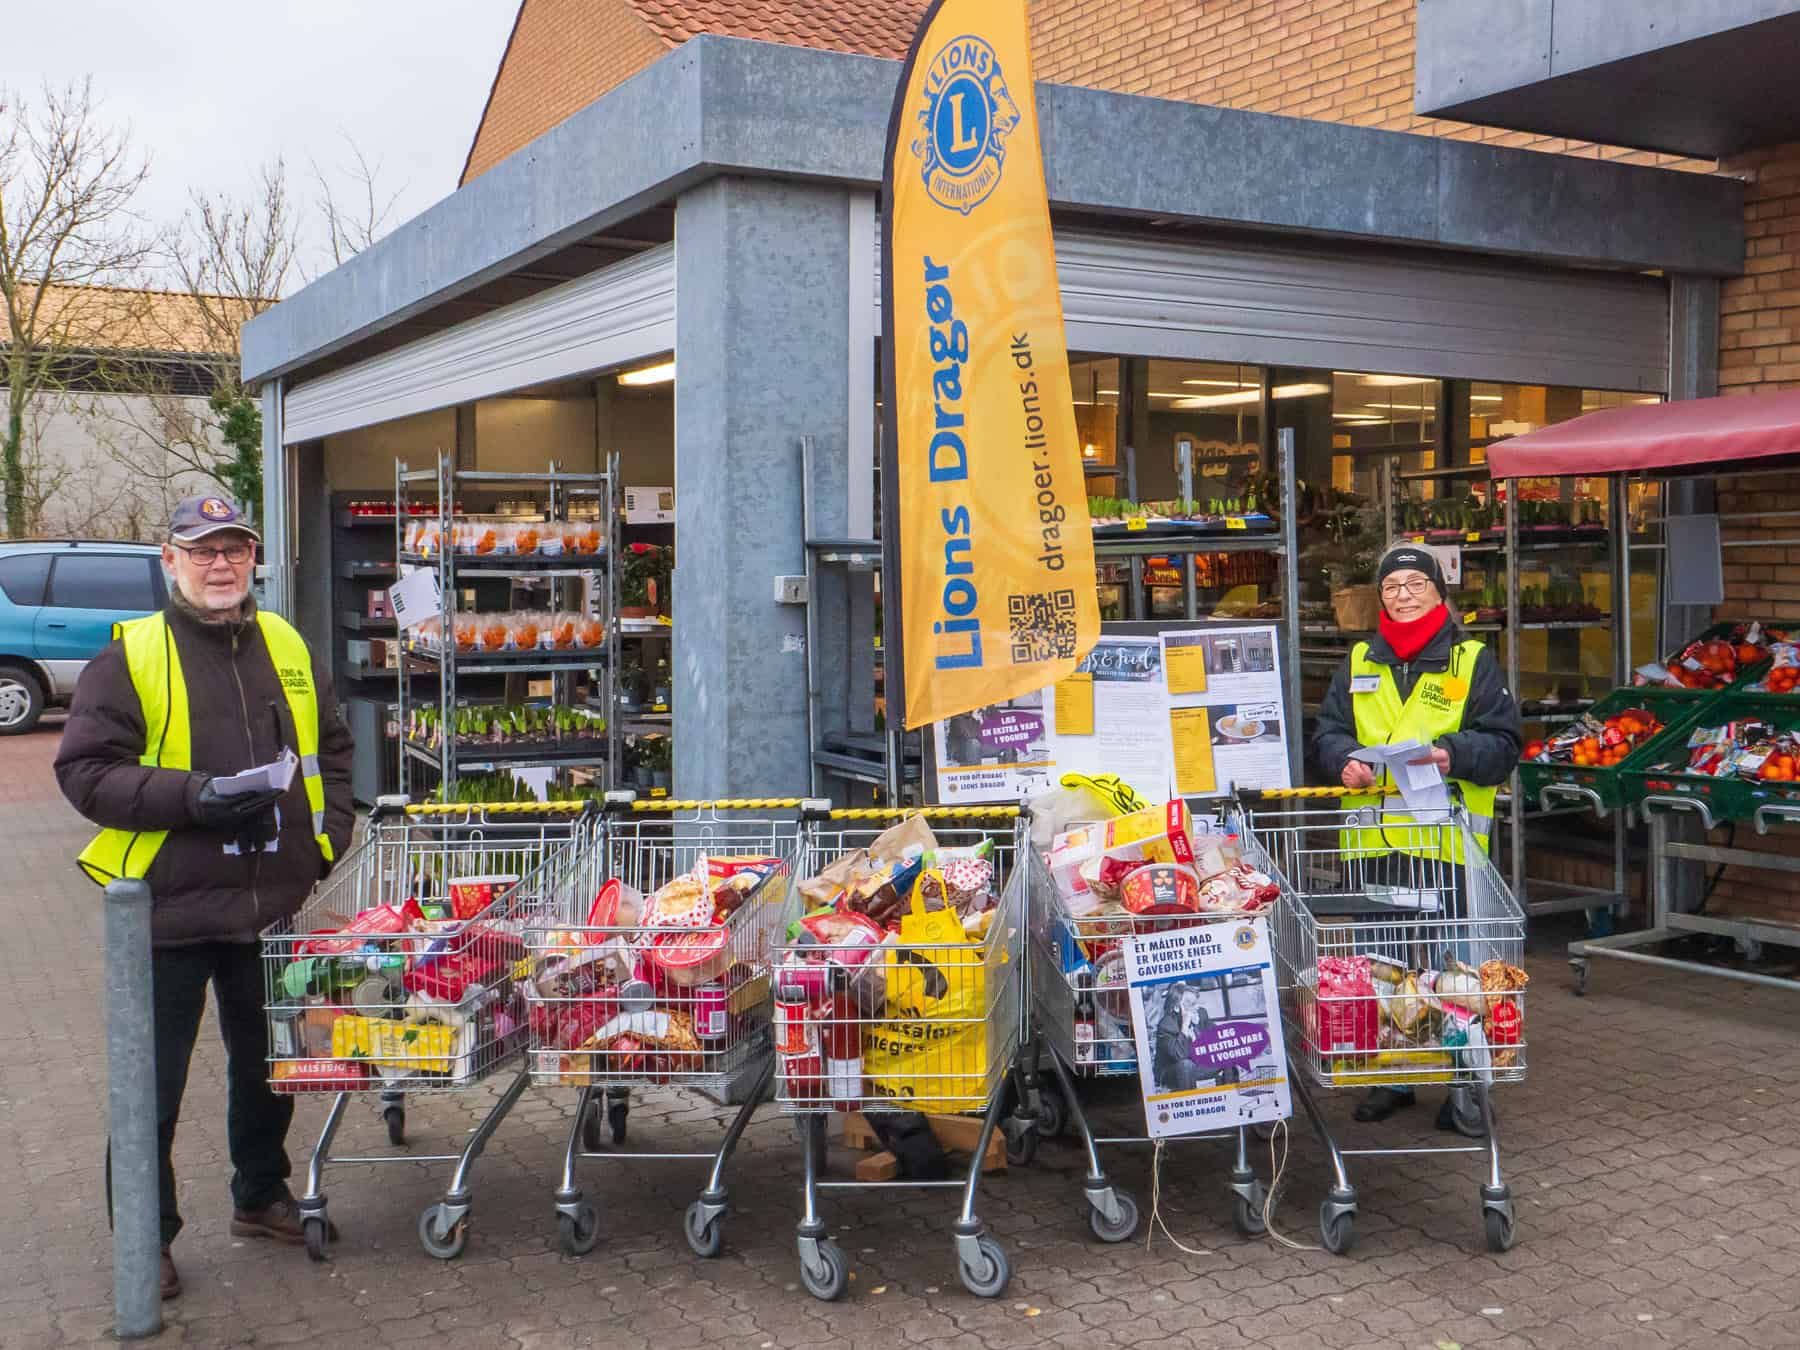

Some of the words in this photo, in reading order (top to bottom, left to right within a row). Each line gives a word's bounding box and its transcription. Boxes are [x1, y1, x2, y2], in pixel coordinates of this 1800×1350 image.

[930, 43, 989, 86] LIONS
[949, 93, 978, 153] L
[934, 167, 992, 200] INTERNATIONAL
[923, 256, 968, 482] Dragør
[1010, 331, 1066, 571] dragoer.lions.dk
[934, 505, 983, 669] Lions
[993, 726, 1018, 735] EKSTRA
[1000, 733, 1029, 743] VOGNEN
[1135, 943, 1145, 953] ET
[1149, 937, 1185, 951] MÅLTID
[1189, 933, 1212, 945] MAD
[1136, 954, 1148, 965] ER
[1152, 949, 1184, 962] KURTS
[1187, 944, 1222, 958] ENESTE
[1208, 1038, 1240, 1053] EKSTRA
[1240, 1032, 1264, 1045] VARE
[1217, 1028, 1236, 1039] LÆG
[1217, 1046, 1252, 1061] VOGNEN
[1173, 1110, 1193, 1119] LIONS
